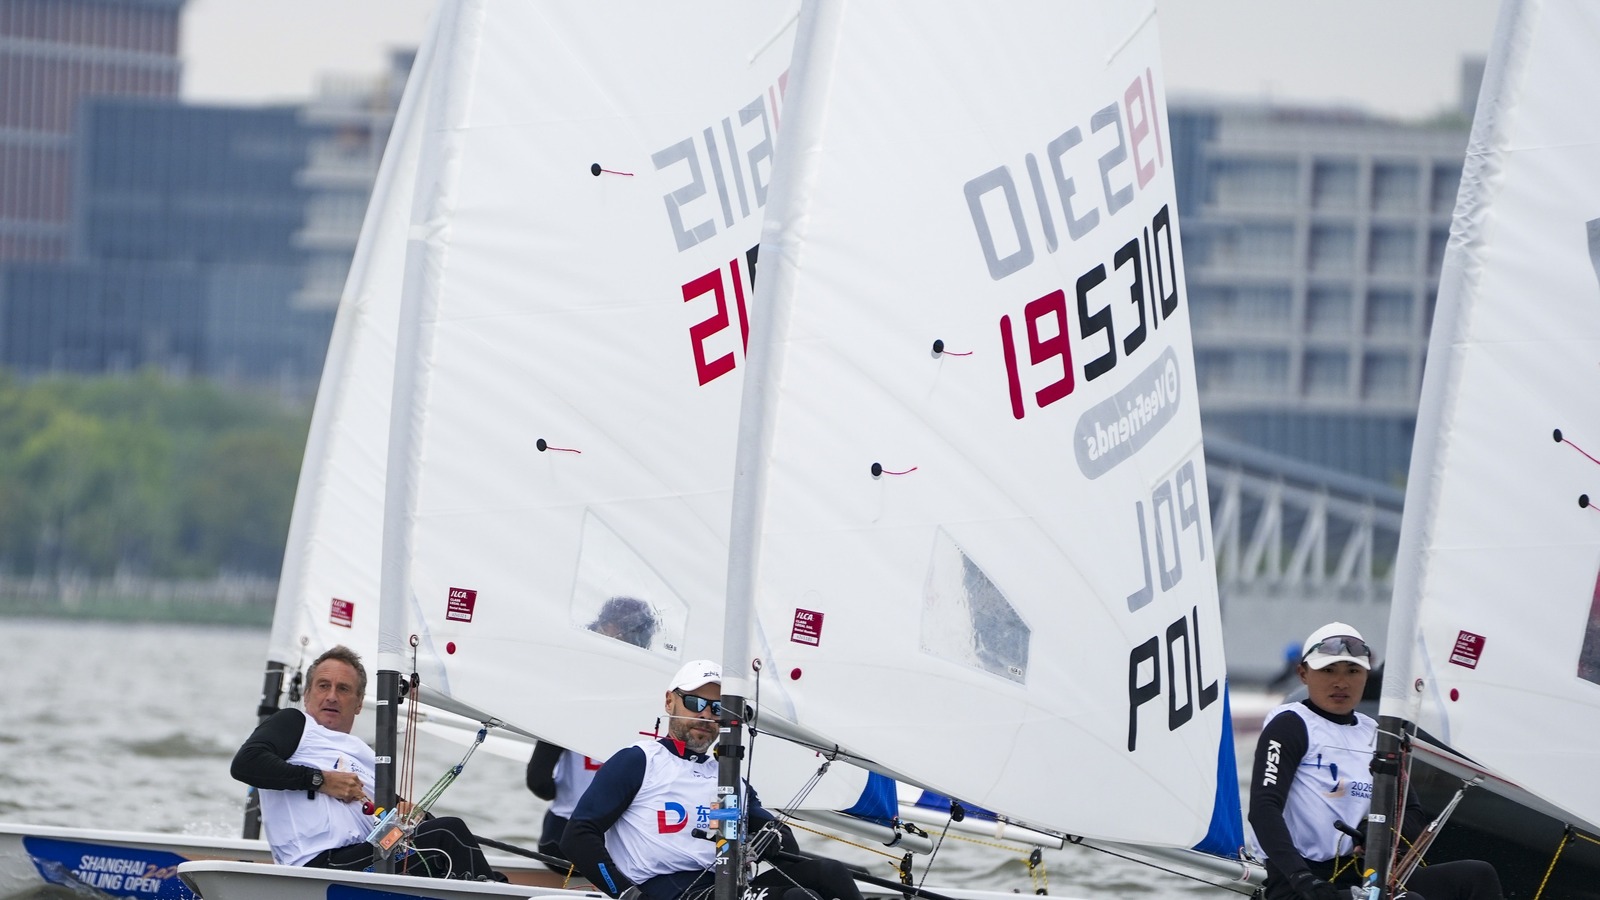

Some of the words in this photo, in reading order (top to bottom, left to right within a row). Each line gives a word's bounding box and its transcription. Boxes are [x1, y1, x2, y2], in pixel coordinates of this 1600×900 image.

[681, 243, 760, 387] 21
[1000, 203, 1179, 420] 195310
[450, 590, 467, 599] ILCA
[796, 611, 814, 621] ILCA
[1127, 605, 1219, 752] POL
[1263, 740, 1282, 786] KSAIL
[79, 855, 147, 876] SHANGHAI
[124, 877, 161, 893] OPEN
